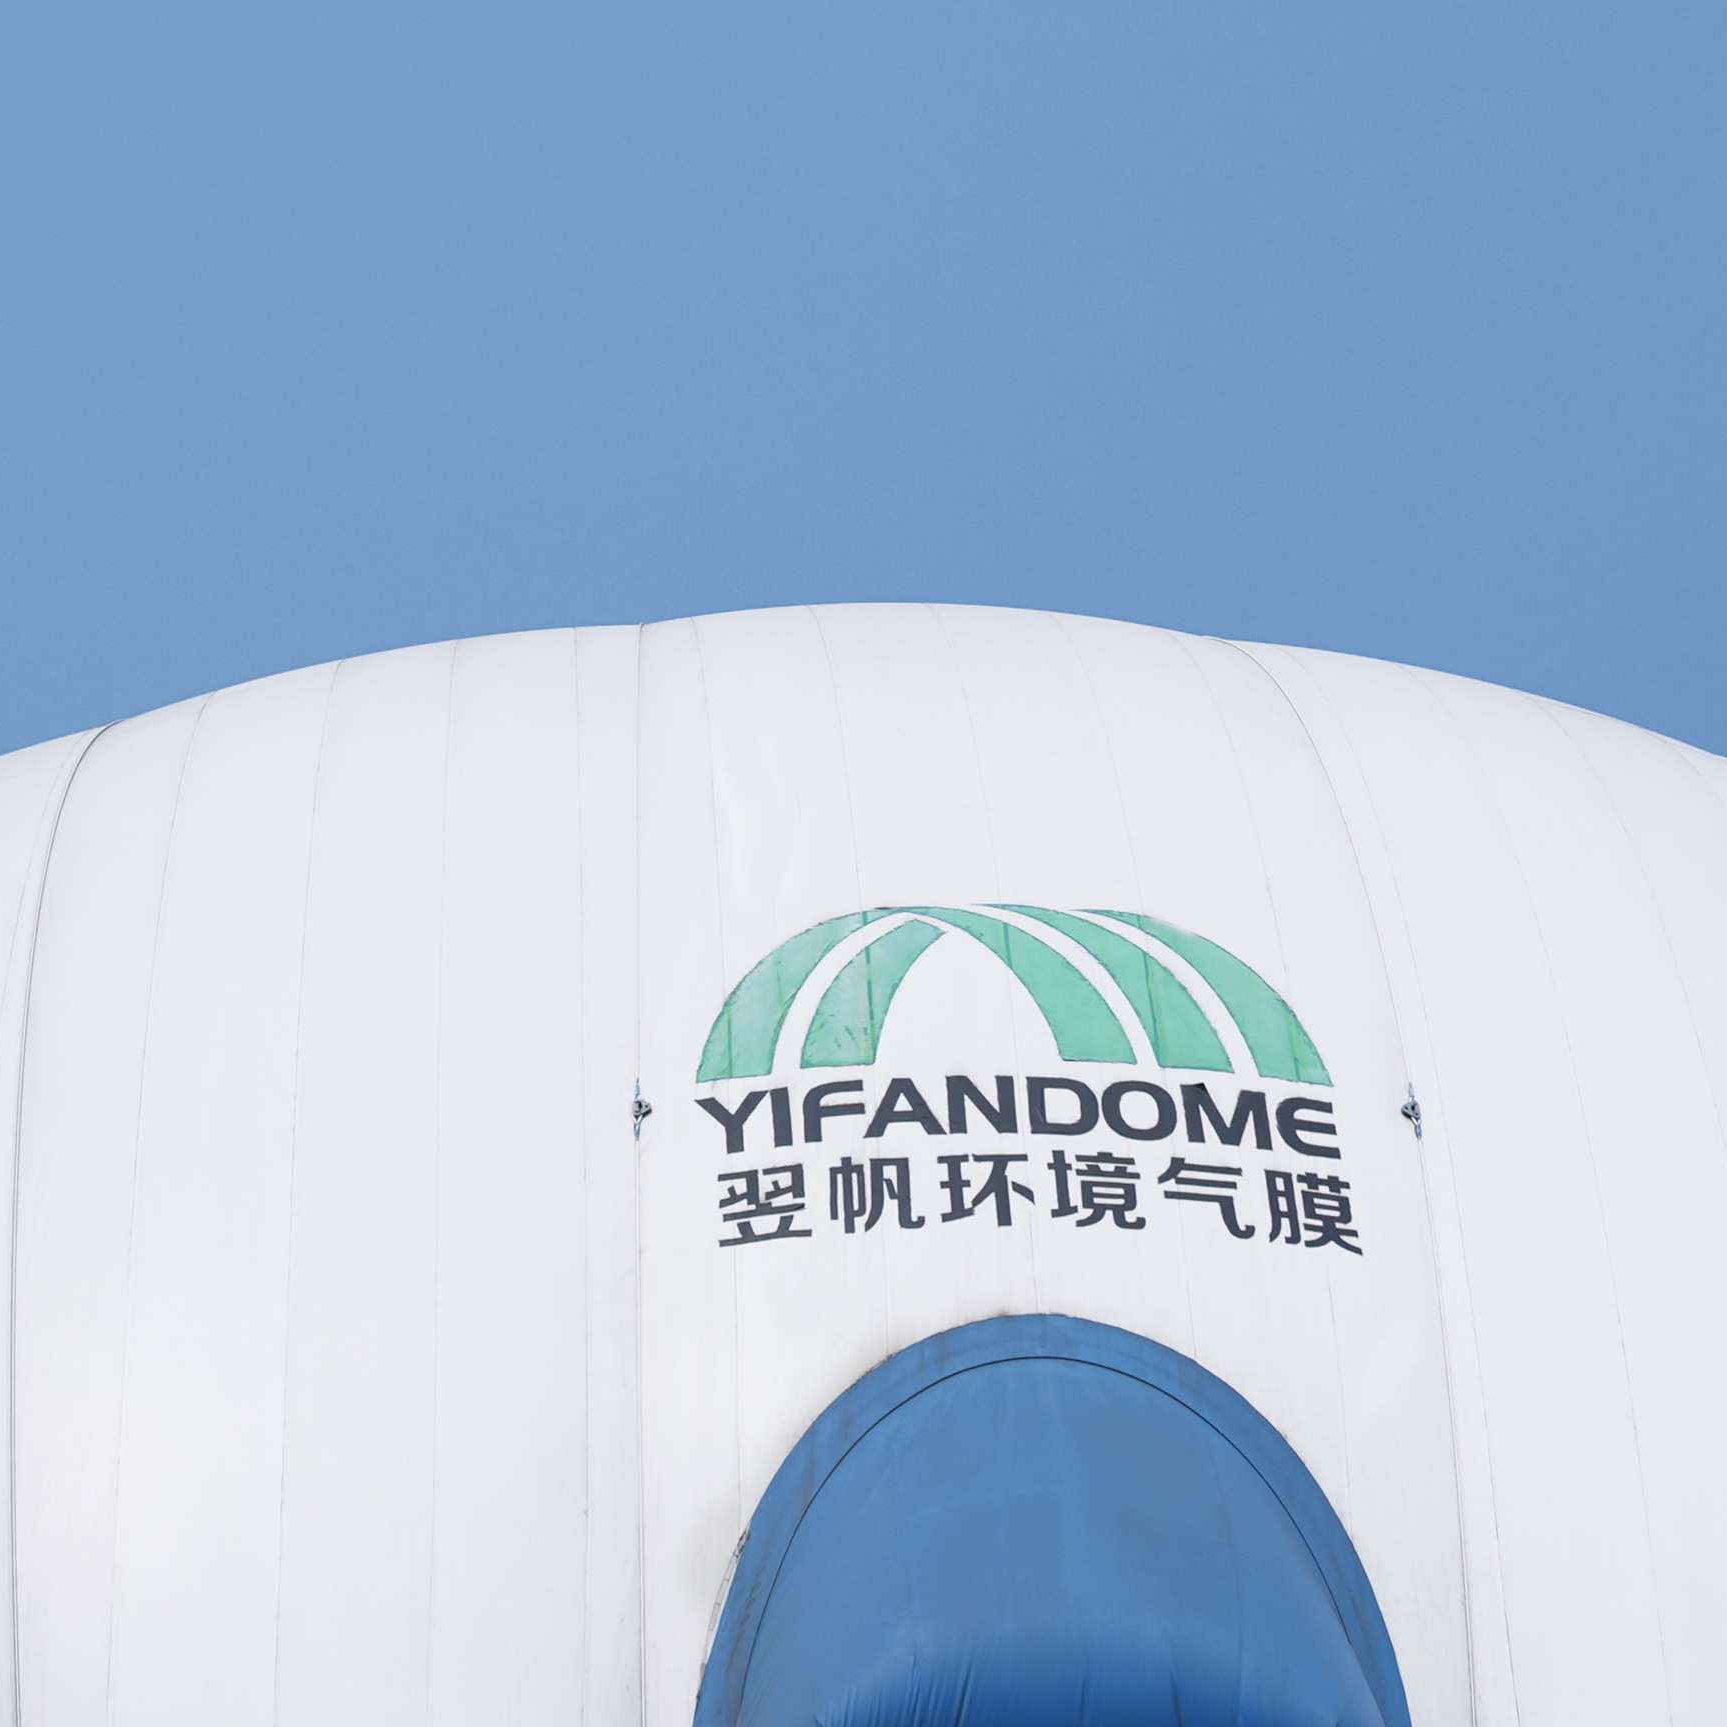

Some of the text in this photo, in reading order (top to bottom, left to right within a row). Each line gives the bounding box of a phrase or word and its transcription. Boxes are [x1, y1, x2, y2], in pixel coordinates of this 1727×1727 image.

[696, 1075, 1341, 1160] YIFANDOME
[717, 1151, 1363, 1256] 翌帆环境气膜
